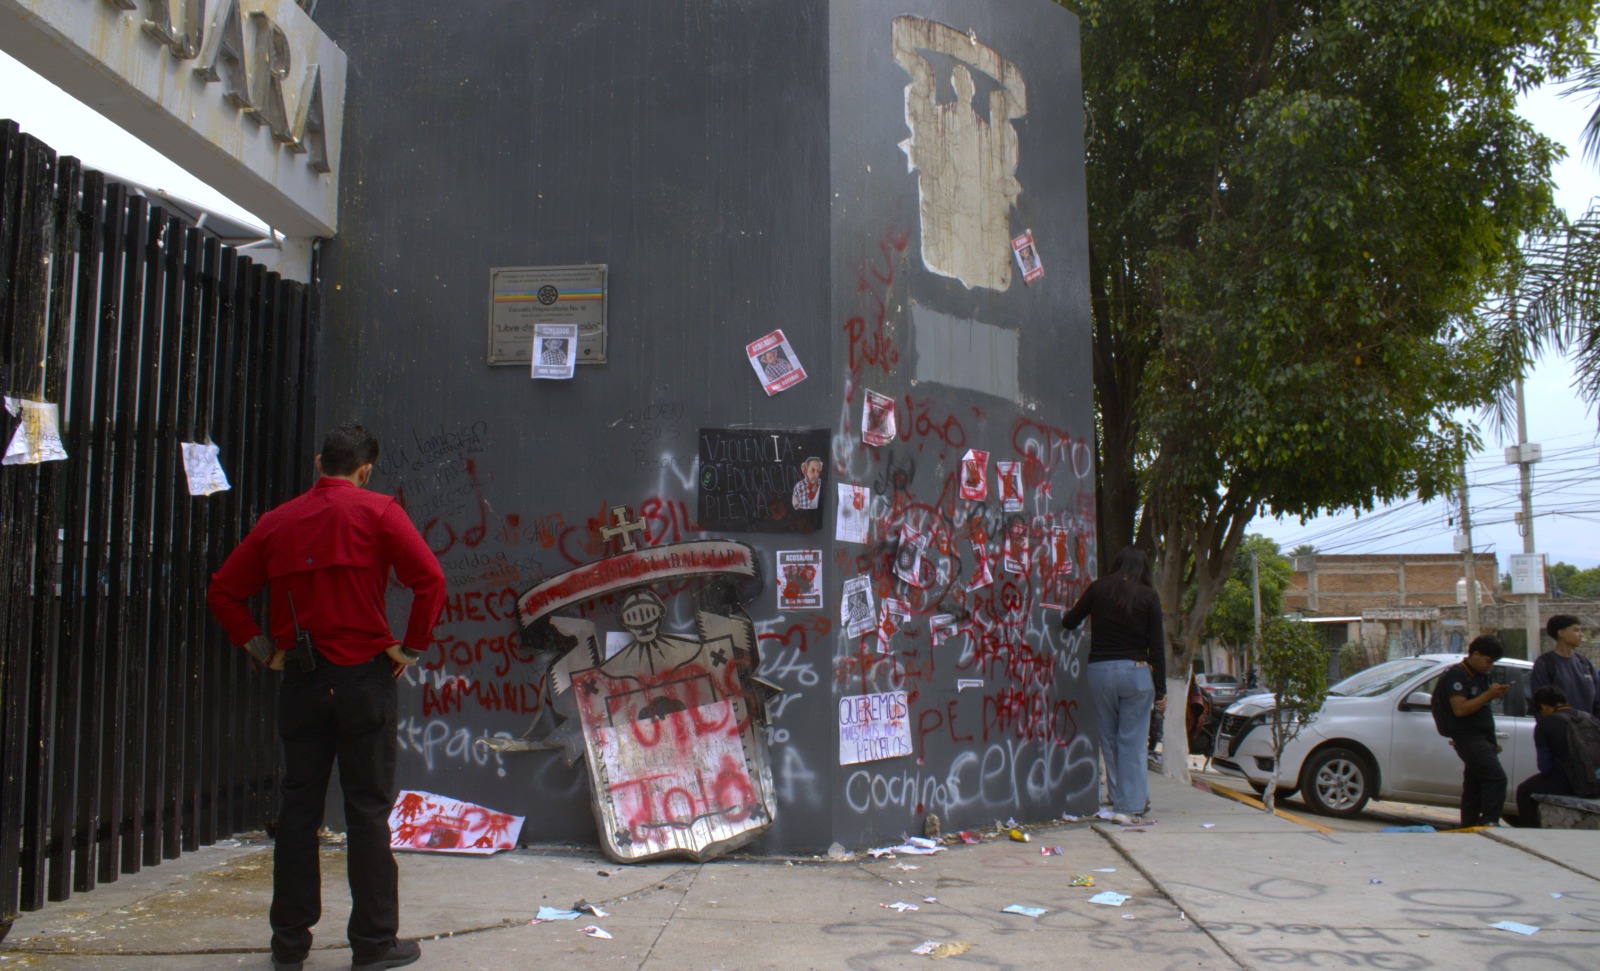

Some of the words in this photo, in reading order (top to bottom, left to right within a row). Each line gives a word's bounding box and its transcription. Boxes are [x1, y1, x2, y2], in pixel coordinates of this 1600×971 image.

[702, 434, 795, 463] VIOLENCIA
[705, 491, 770, 520] PLENA
[639, 549, 748, 572] GUADALAJARA
[422, 674, 553, 717] ARMAND
[840, 693, 907, 726] QUEREMOS
